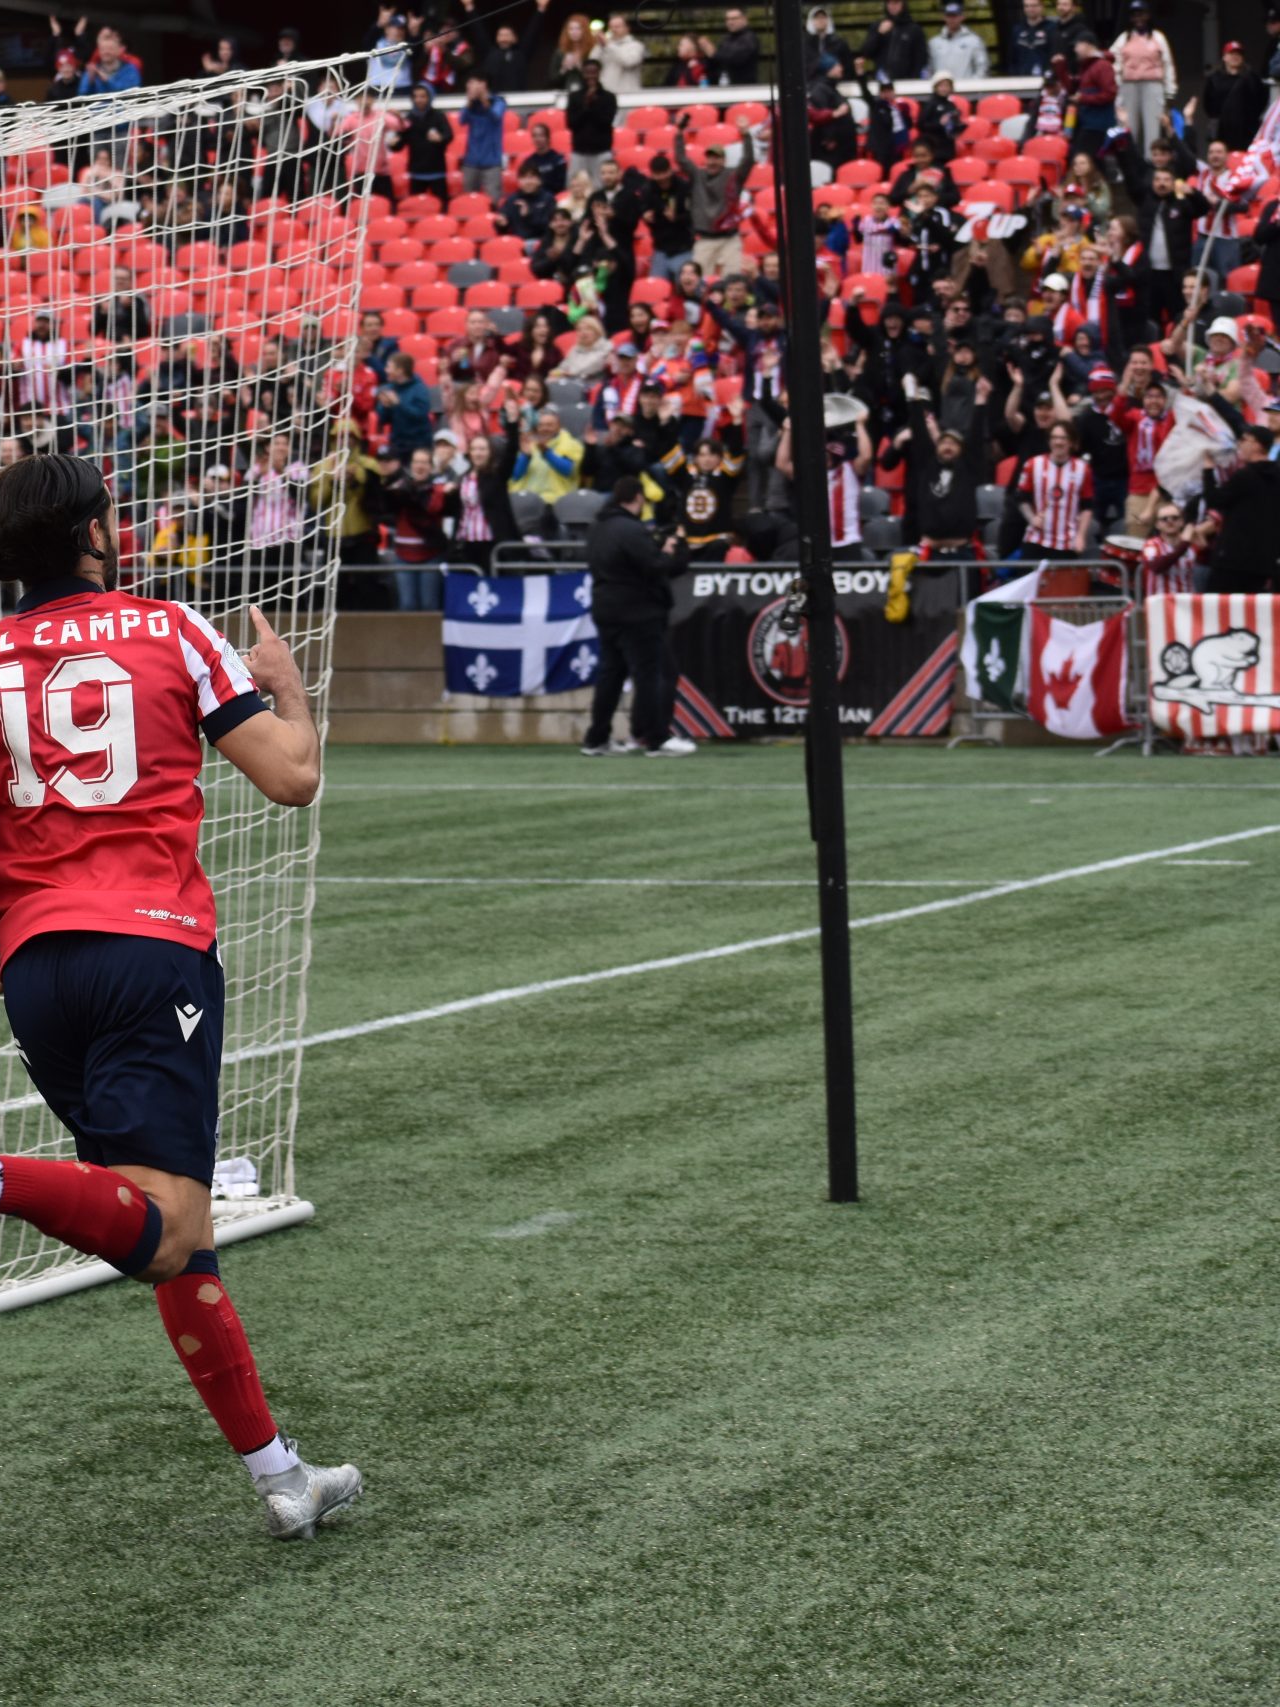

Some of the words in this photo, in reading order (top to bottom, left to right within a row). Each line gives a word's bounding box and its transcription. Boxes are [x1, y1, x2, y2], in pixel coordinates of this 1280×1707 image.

[693, 571, 801, 597] BYTOW
[832, 570, 911, 594] BOY
[33, 609, 170, 646] CAMPO
[773, 705, 808, 724] 12T
[838, 705, 872, 723] AN
